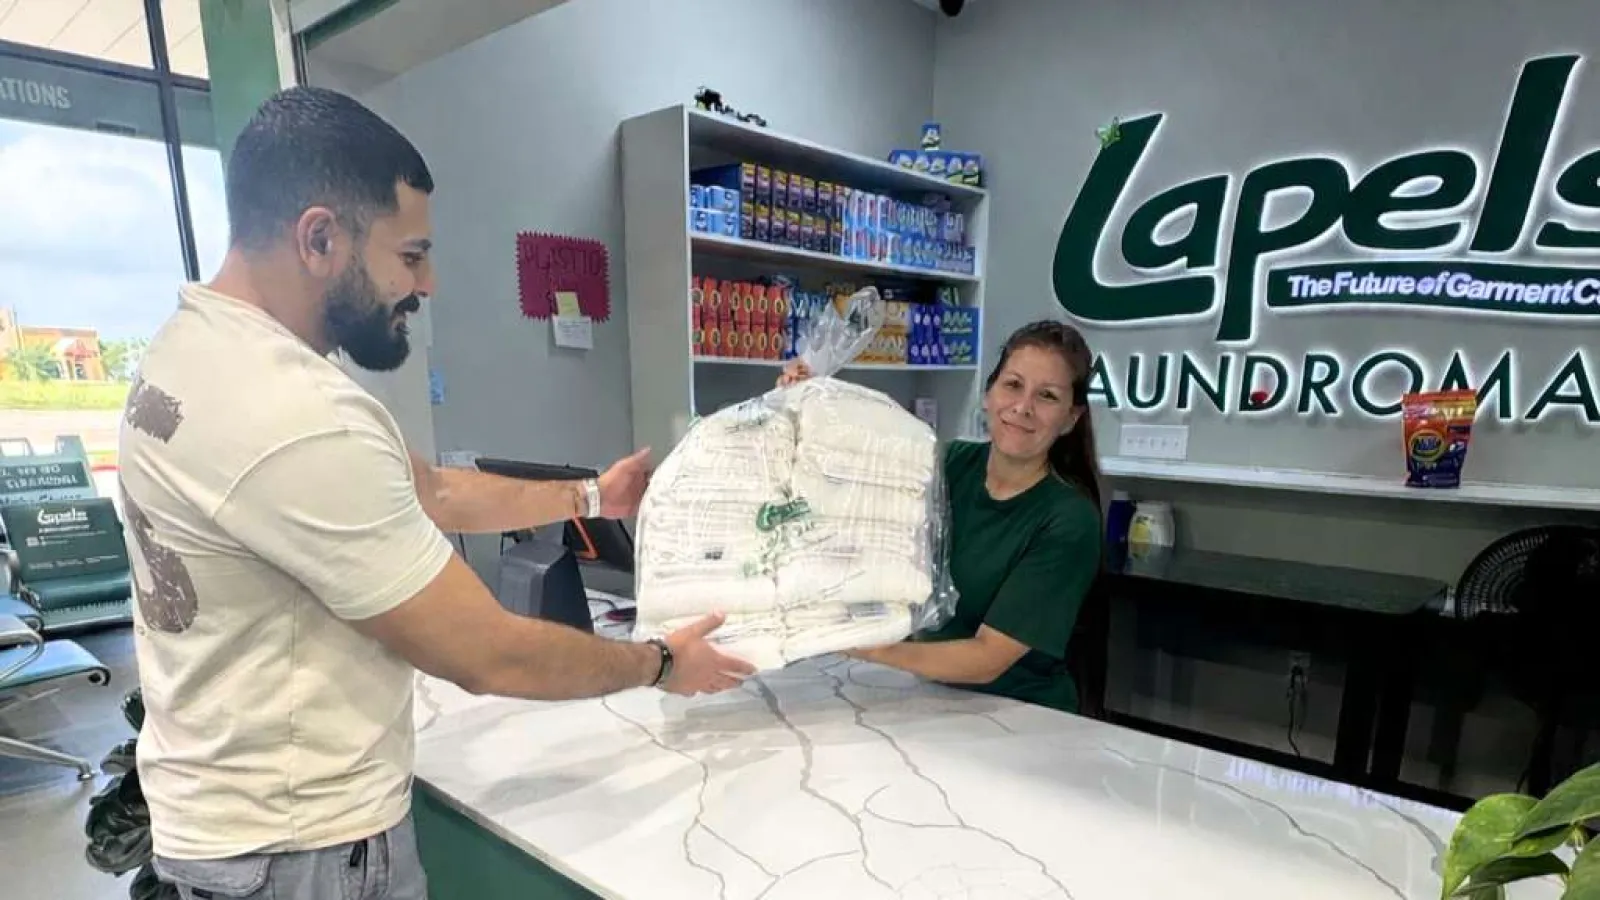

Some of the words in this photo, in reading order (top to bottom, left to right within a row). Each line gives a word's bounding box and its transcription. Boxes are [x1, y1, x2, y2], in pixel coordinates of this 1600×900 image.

[1053, 55, 1600, 343] Lapels
[1288, 274, 1332, 298] The
[1333, 271, 1415, 295] Future
[1417, 270, 1450, 296] of
[1446, 272, 1573, 304] Garment
[1573, 278, 1600, 305] C
